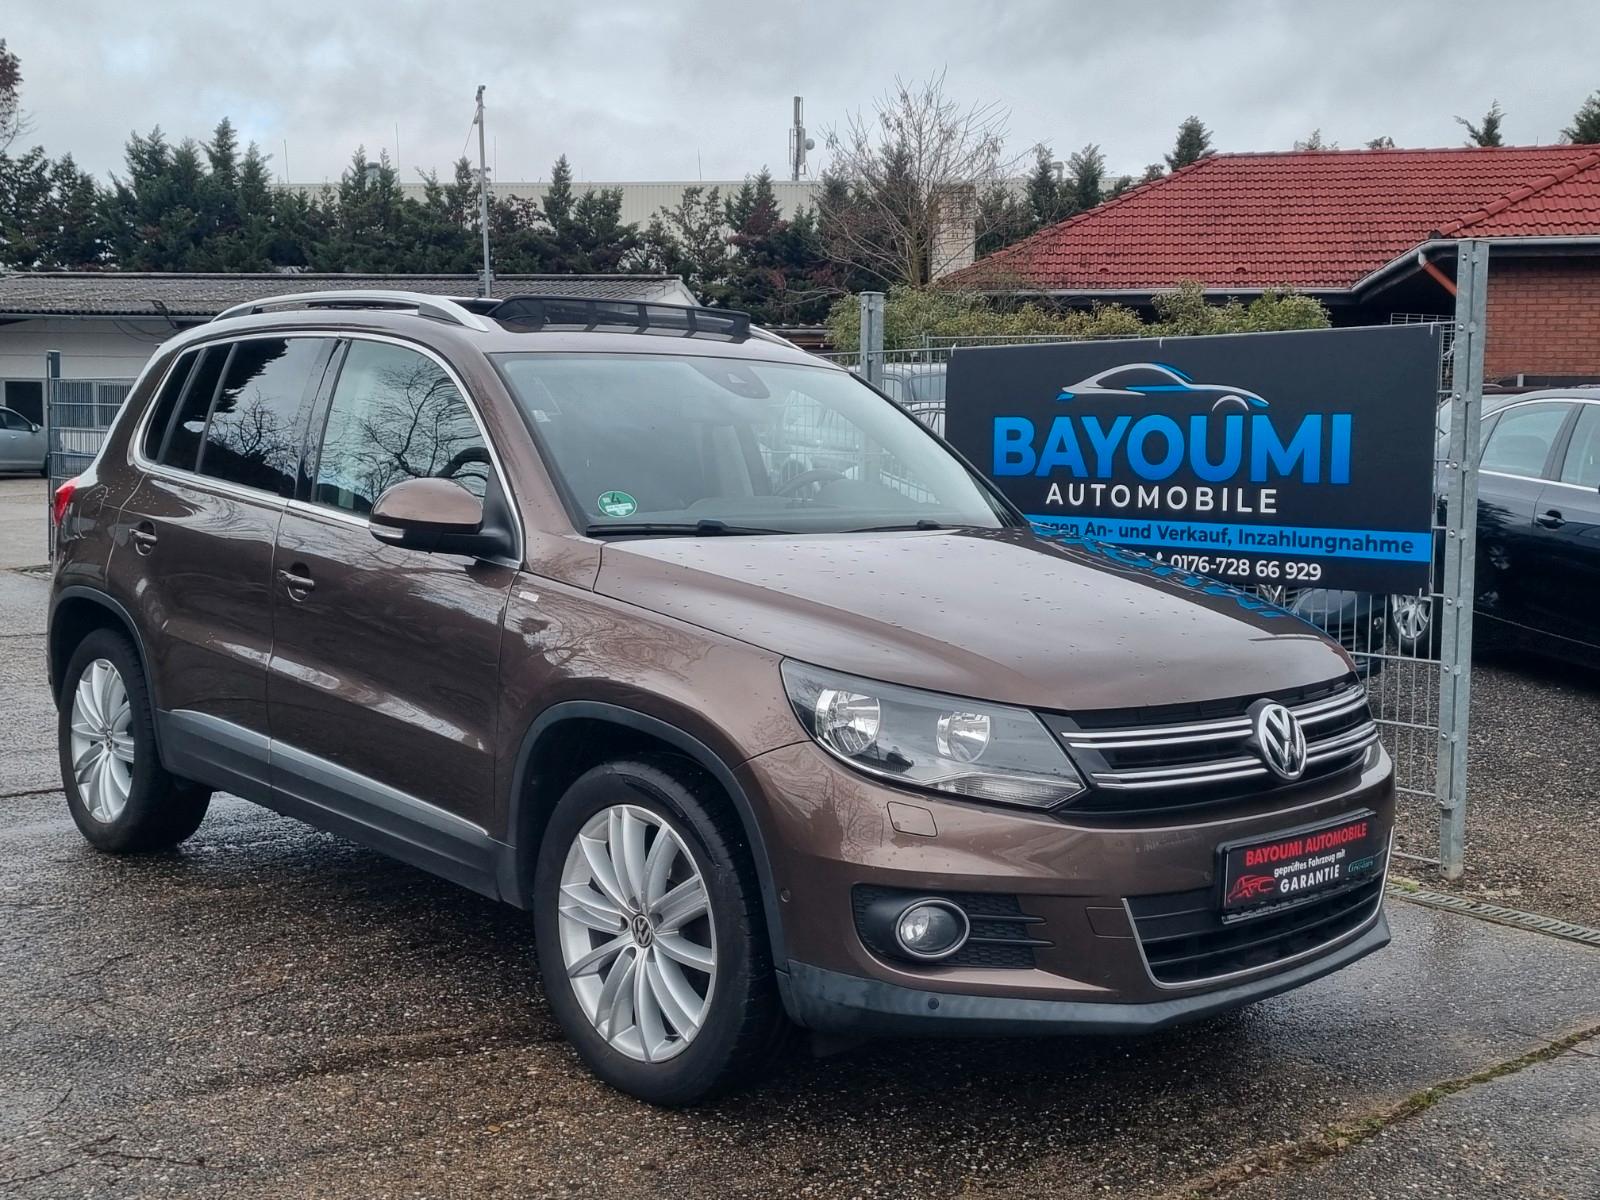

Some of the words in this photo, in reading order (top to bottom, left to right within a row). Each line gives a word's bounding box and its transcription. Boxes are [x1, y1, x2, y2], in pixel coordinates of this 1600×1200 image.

[993, 413, 1352, 484] BAYOUMI
[1046, 483, 1278, 513] AUTOMOBILE
[1084, 521, 1113, 537] An-
[1119, 524, 1151, 539] und
[1157, 525, 1232, 546] Verkauf,
[1238, 528, 1413, 554] Inzahlungnahme
[1171, 554, 1250, 576] 0176-728
[1255, 560, 1280, 578] 66
[1285, 562, 1322, 580] 929
[1259, 704, 1306, 779] VW
[1246, 839, 1302, 867] BAYOUMI
[1305, 822, 1368, 854] AUTOMOBILE
[1308, 852, 1336, 869] Fahrzeug
[1280, 864, 1340, 893] GARANTIE
